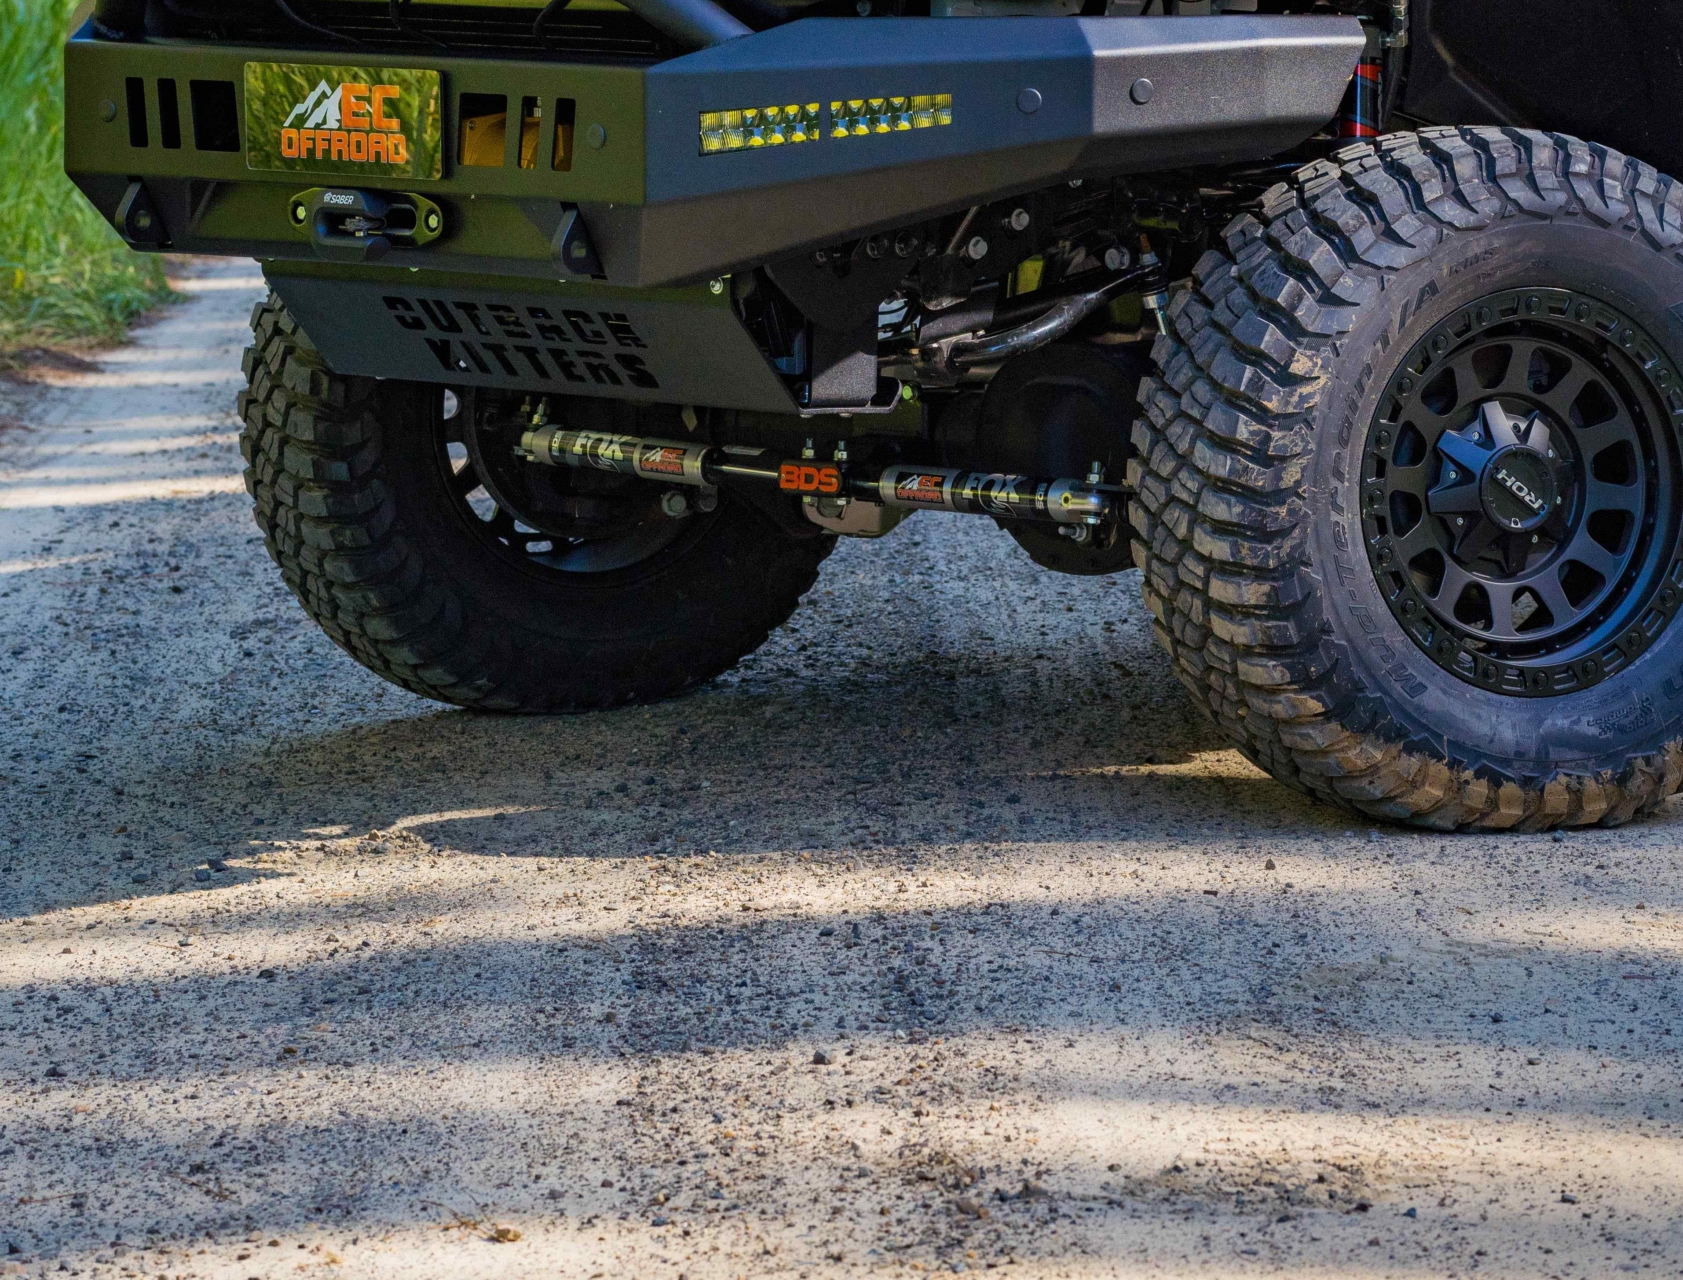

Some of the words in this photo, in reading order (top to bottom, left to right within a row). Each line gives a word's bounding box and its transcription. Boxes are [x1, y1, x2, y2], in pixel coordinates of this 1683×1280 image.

[340, 83, 401, 131] EC
[281, 128, 407, 164] OFFROAD
[331, 194, 354, 205] SABER
[382, 295, 648, 349] OUTBACK
[424, 337, 660, 388] KITTERS
[572, 431, 632, 465] FOX
[779, 464, 838, 493] BDS
[897, 489, 942, 503] OFFROAD
[918, 476, 942, 489] EC
[961, 472, 1027, 508] FOX
[1496, 469, 1543, 509] ROH
